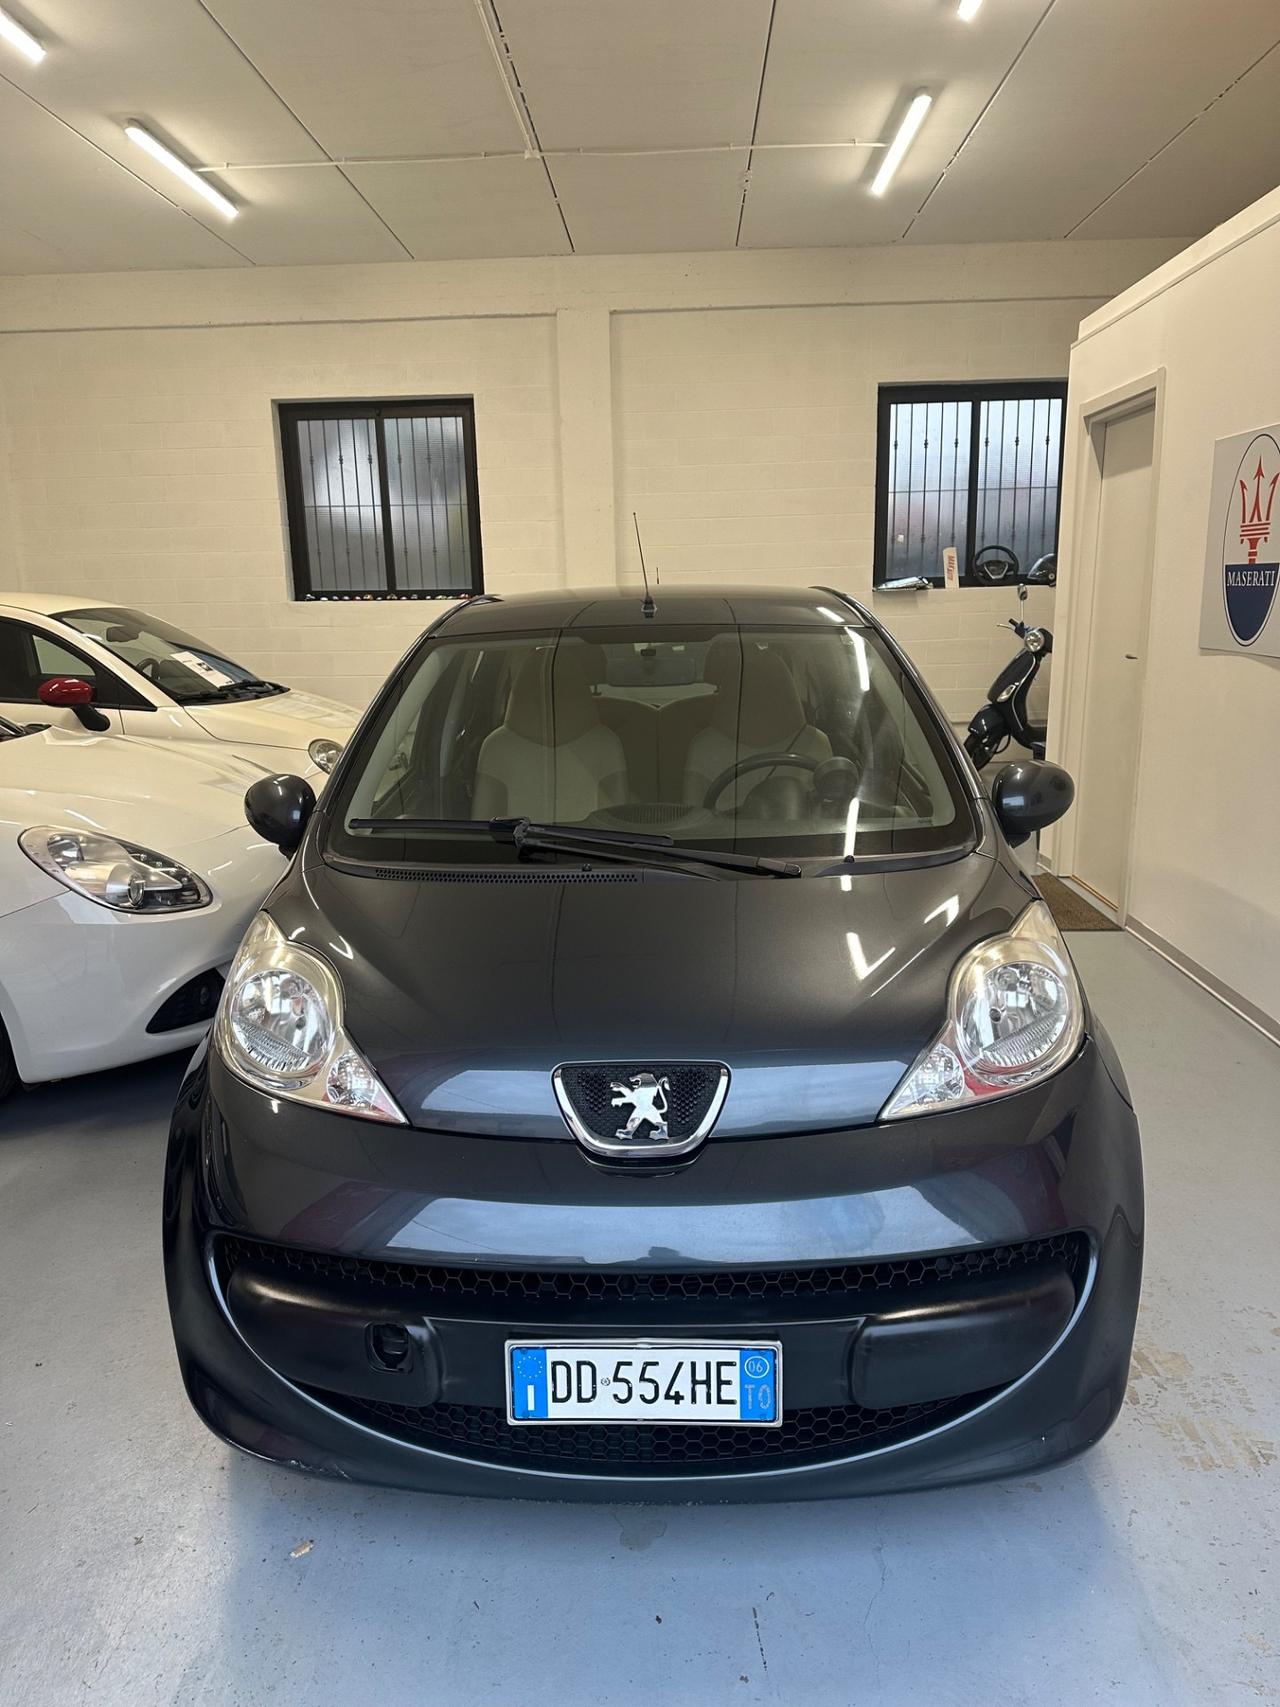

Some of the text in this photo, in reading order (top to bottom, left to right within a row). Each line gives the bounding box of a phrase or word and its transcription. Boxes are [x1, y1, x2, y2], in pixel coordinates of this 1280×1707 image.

[1227, 570, 1275, 587] MASERATI
[748, 1360, 763, 1373] 06
[527, 1385, 535, 1411] I
[744, 1384, 771, 1410] TO
